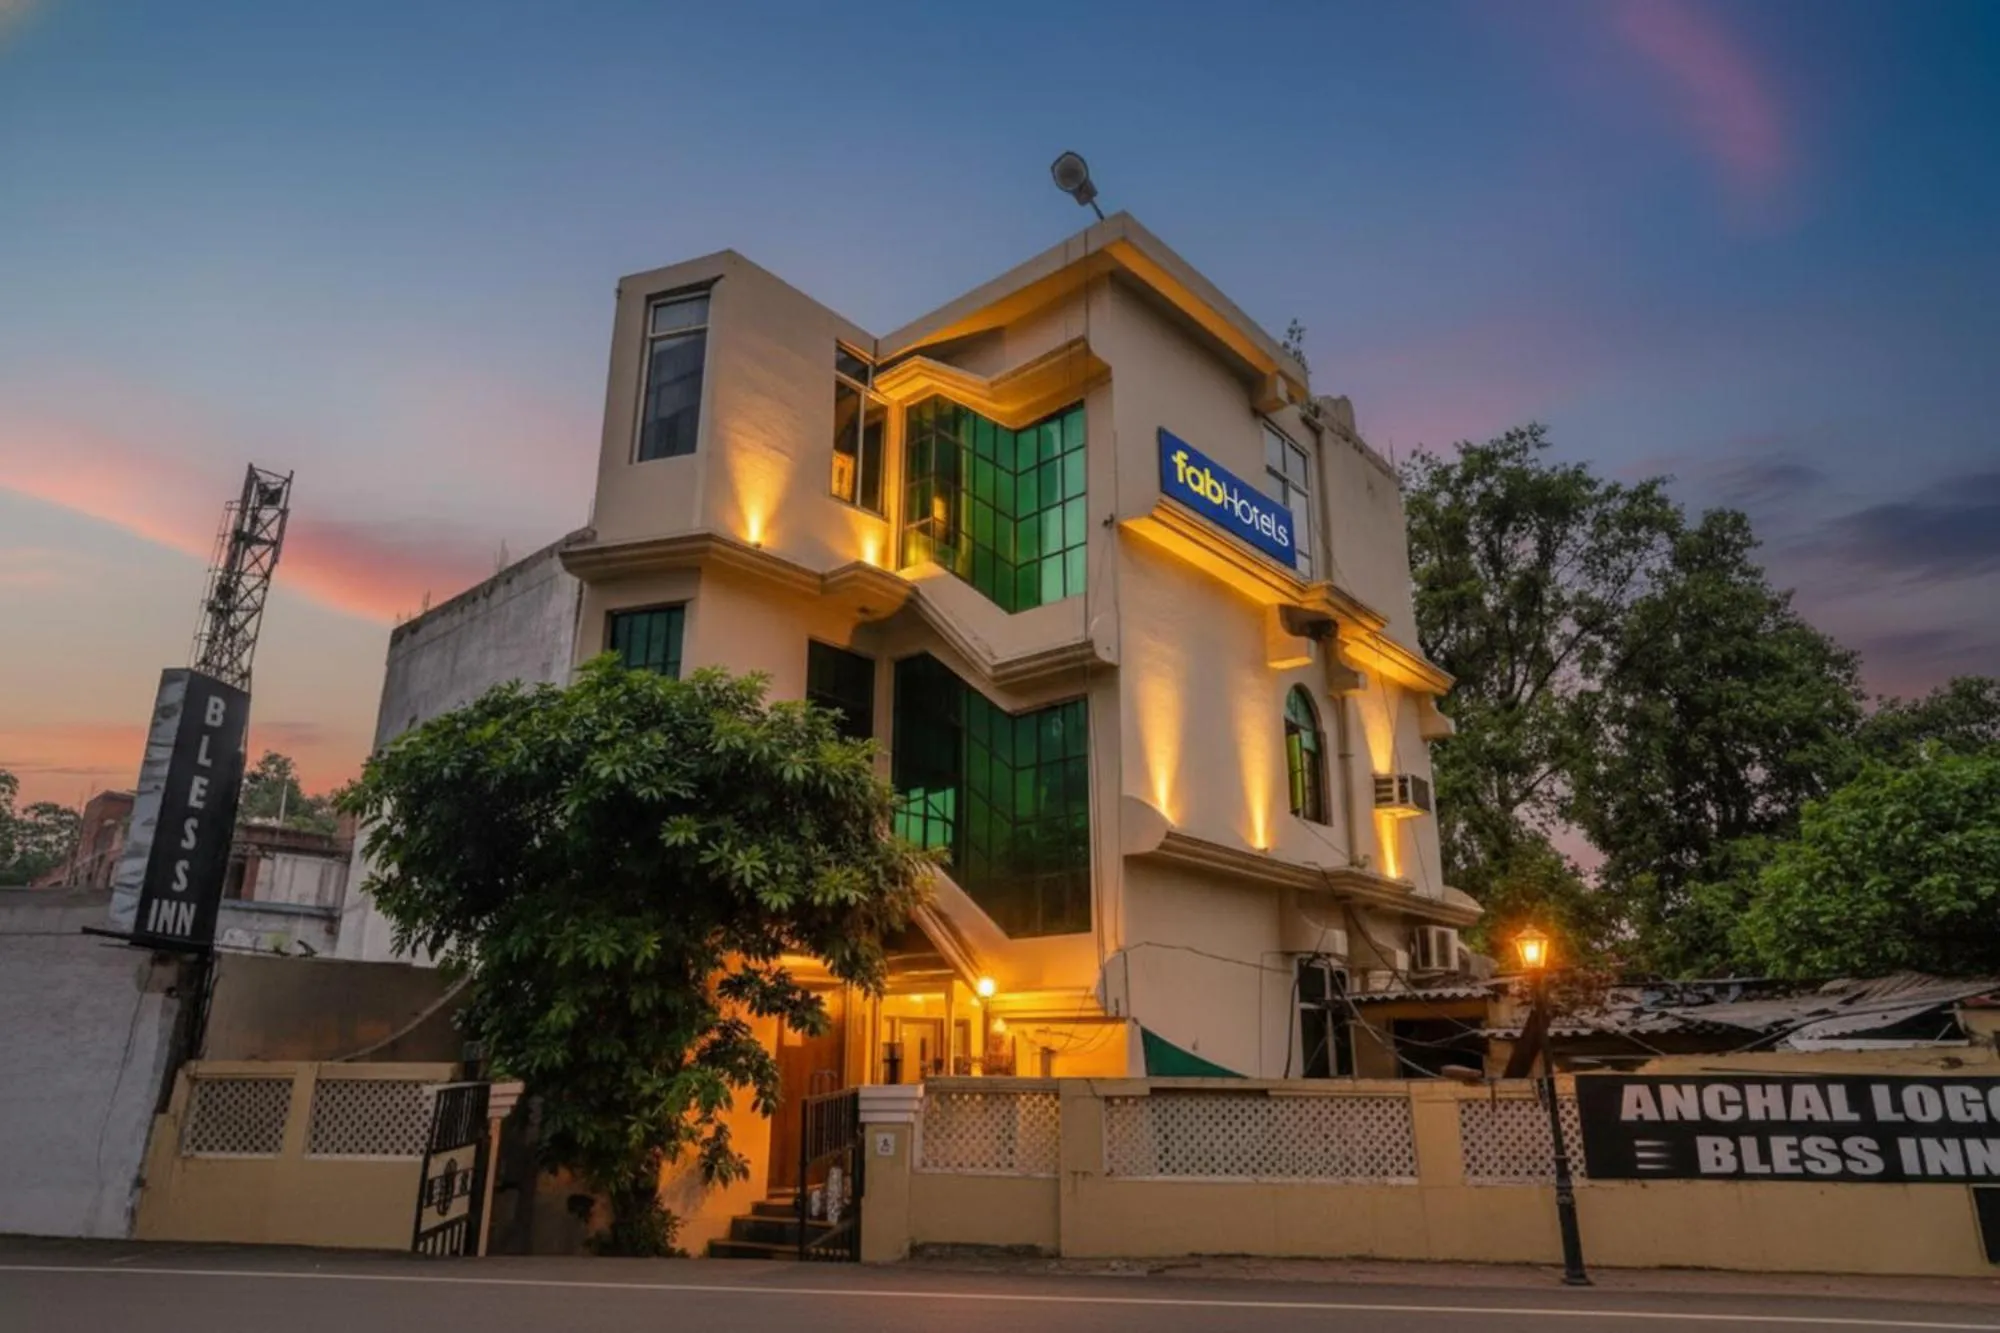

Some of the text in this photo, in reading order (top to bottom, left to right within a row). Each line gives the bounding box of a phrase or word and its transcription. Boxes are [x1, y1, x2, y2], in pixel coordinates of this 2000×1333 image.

[1171, 450, 1289, 547] fabHotels
[171, 696, 227, 892] BLESS
[146, 899, 196, 936] INN
[1620, 1084, 1860, 1122] ANCHAL
[1696, 1136, 2000, 1175] BLESS INN
